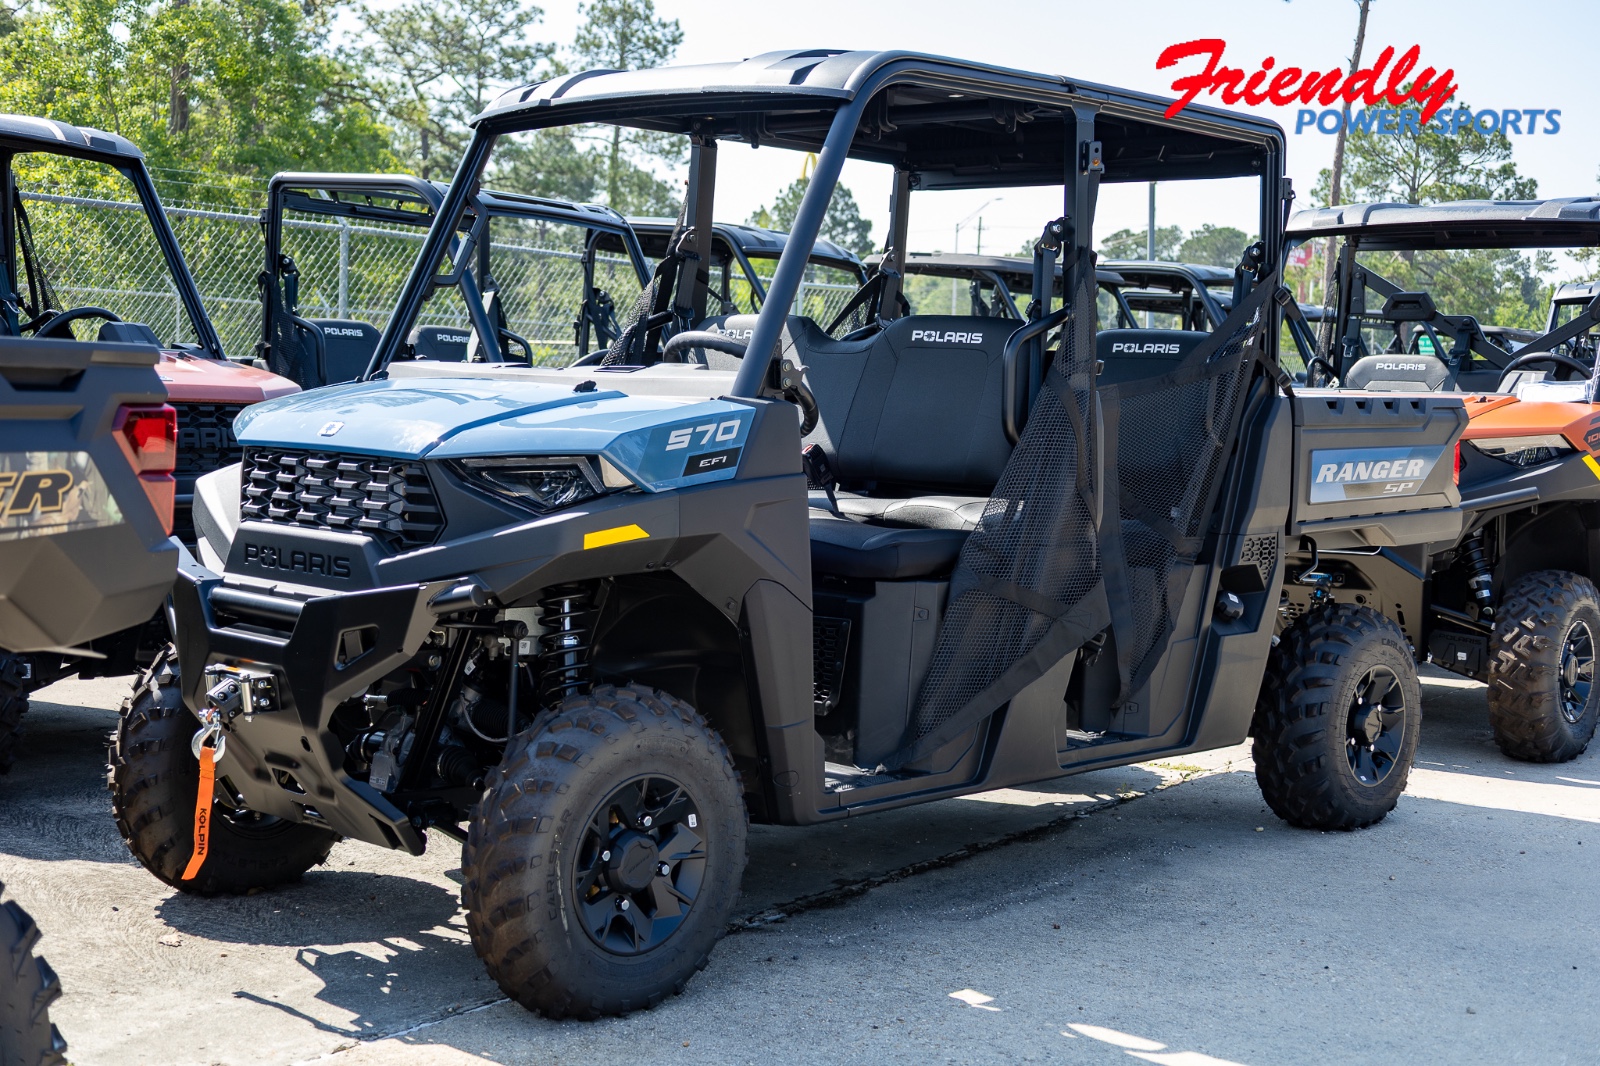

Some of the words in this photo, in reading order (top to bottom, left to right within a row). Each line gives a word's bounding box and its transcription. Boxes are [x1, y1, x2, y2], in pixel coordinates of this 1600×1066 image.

[324, 327, 363, 337] POLARIS
[912, 330, 983, 344] POLARIS
[1112, 343, 1180, 354] POLARIS
[1375, 362, 1426, 371] POLARIS
[665, 419, 741, 451] 570
[699, 456, 727, 468] EFI
[1315, 459, 1425, 484] RANGER
[1383, 482, 1415, 494] SP
[244, 543, 352, 579] POLARIS
[1439, 633, 1482, 646] POLARIS
[198, 807, 207, 856] KOLPIN
[546, 808, 572, 920] CARLSTAR
